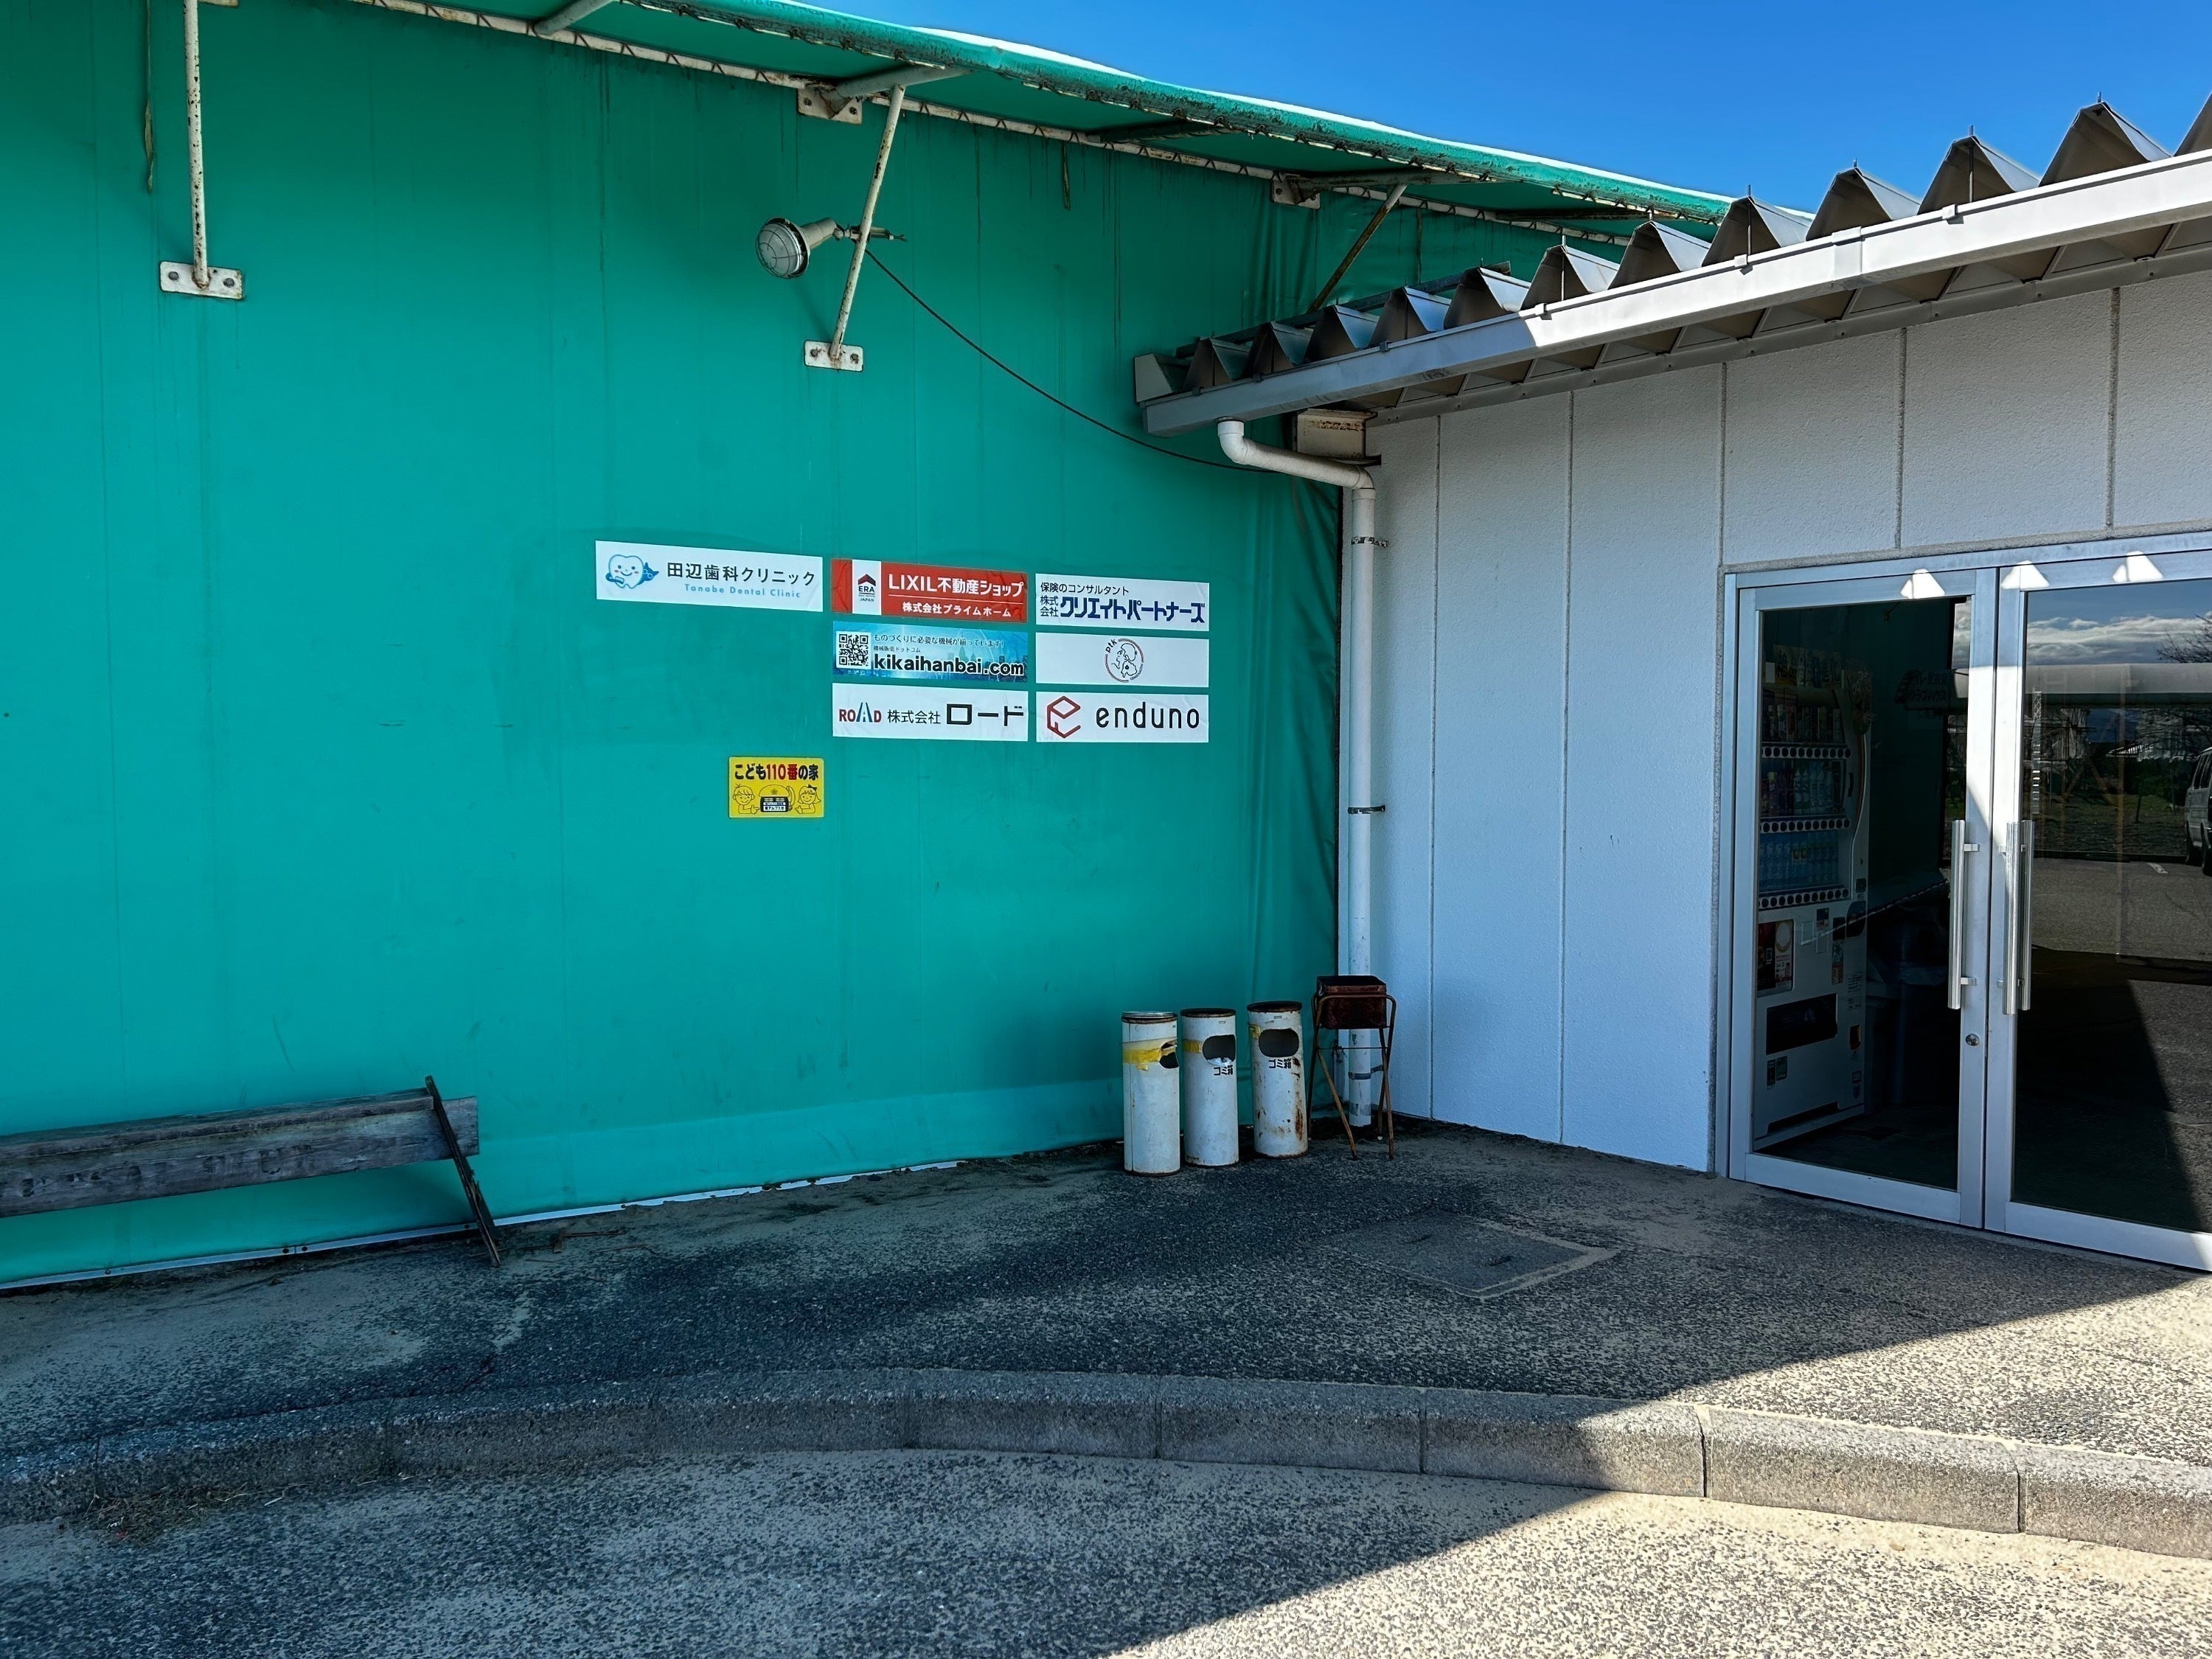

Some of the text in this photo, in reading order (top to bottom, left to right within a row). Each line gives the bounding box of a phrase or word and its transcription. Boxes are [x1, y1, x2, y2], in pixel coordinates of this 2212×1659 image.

[667, 562, 815, 586] 田辺歯科クリニック
[684, 583, 801, 598] Tanabe Dental Clinic
[888, 573, 1024, 598] LIXIL不動産ショップ
[1040, 582, 1129, 596] 保険のコンサルタント
[902, 602, 1011, 617] 株式会社プライムホーム
[1040, 595, 1059, 606] 株式
[1040, 607, 1059, 617] 会社
[1060, 597, 1206, 624] クリエイトパートナーズ
[1105, 638, 1118, 653] ptk
[874, 654, 1024, 675] kikaihanbai.com
[838, 702, 1024, 727] ROAD 株式会社 ロード
[1096, 701, 1200, 729] enduno
[734, 762, 819, 781] こども110番の家
